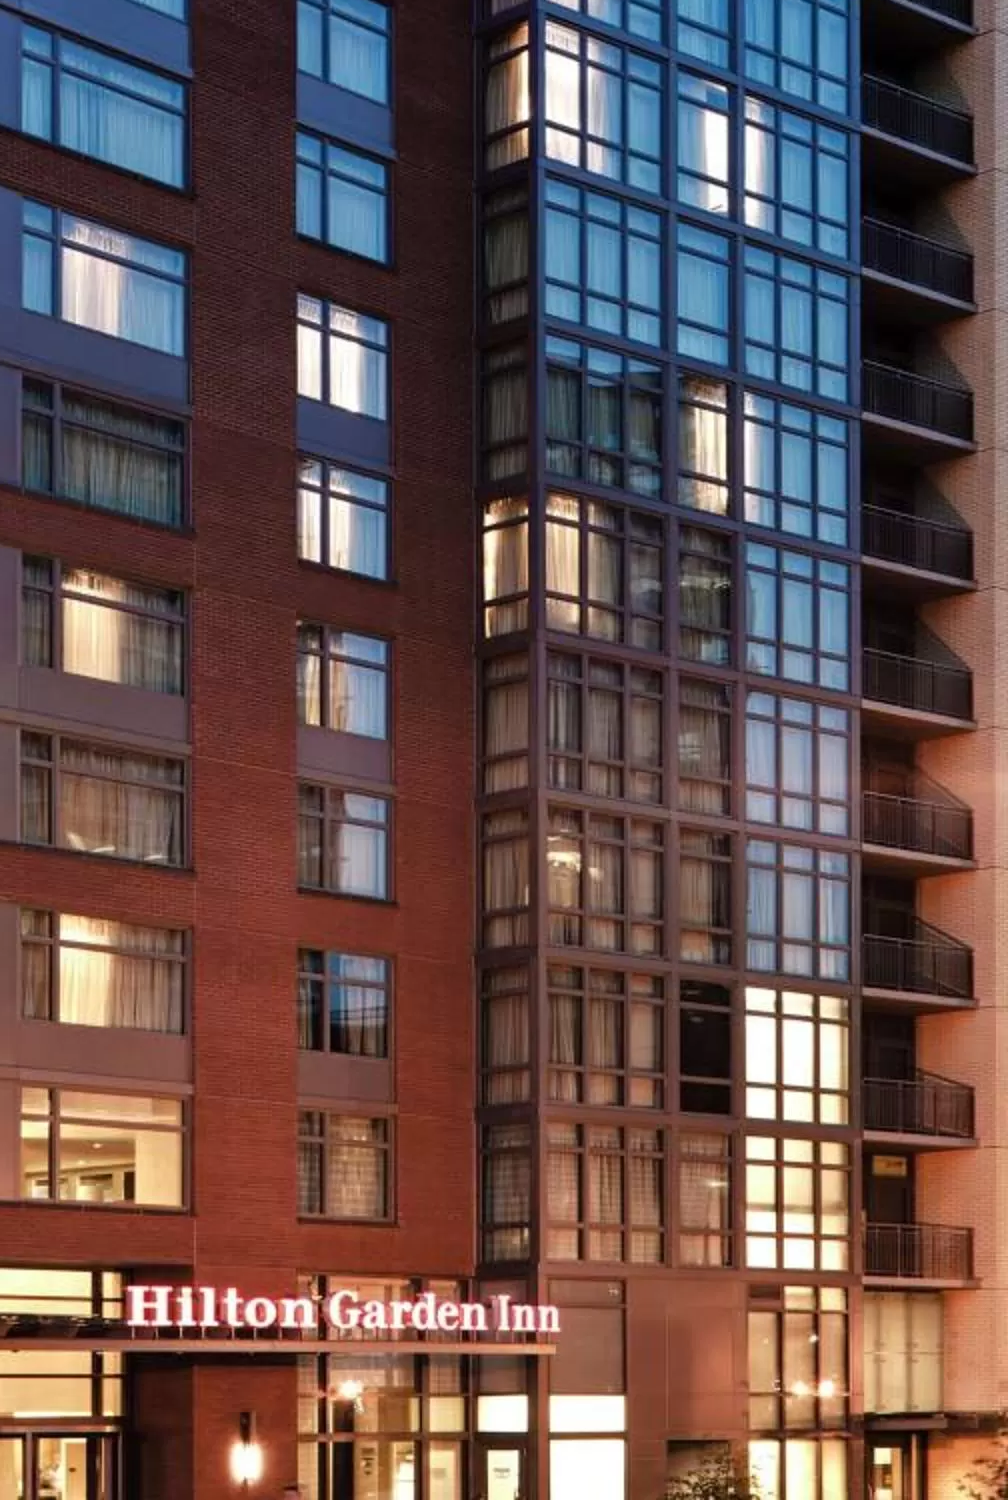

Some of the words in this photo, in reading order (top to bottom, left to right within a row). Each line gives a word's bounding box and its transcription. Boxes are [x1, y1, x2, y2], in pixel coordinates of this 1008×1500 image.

[126, 1285, 317, 1328] Hilton
[329, 1290, 488, 1332] Garden
[497, 1294, 561, 1333] Inn
